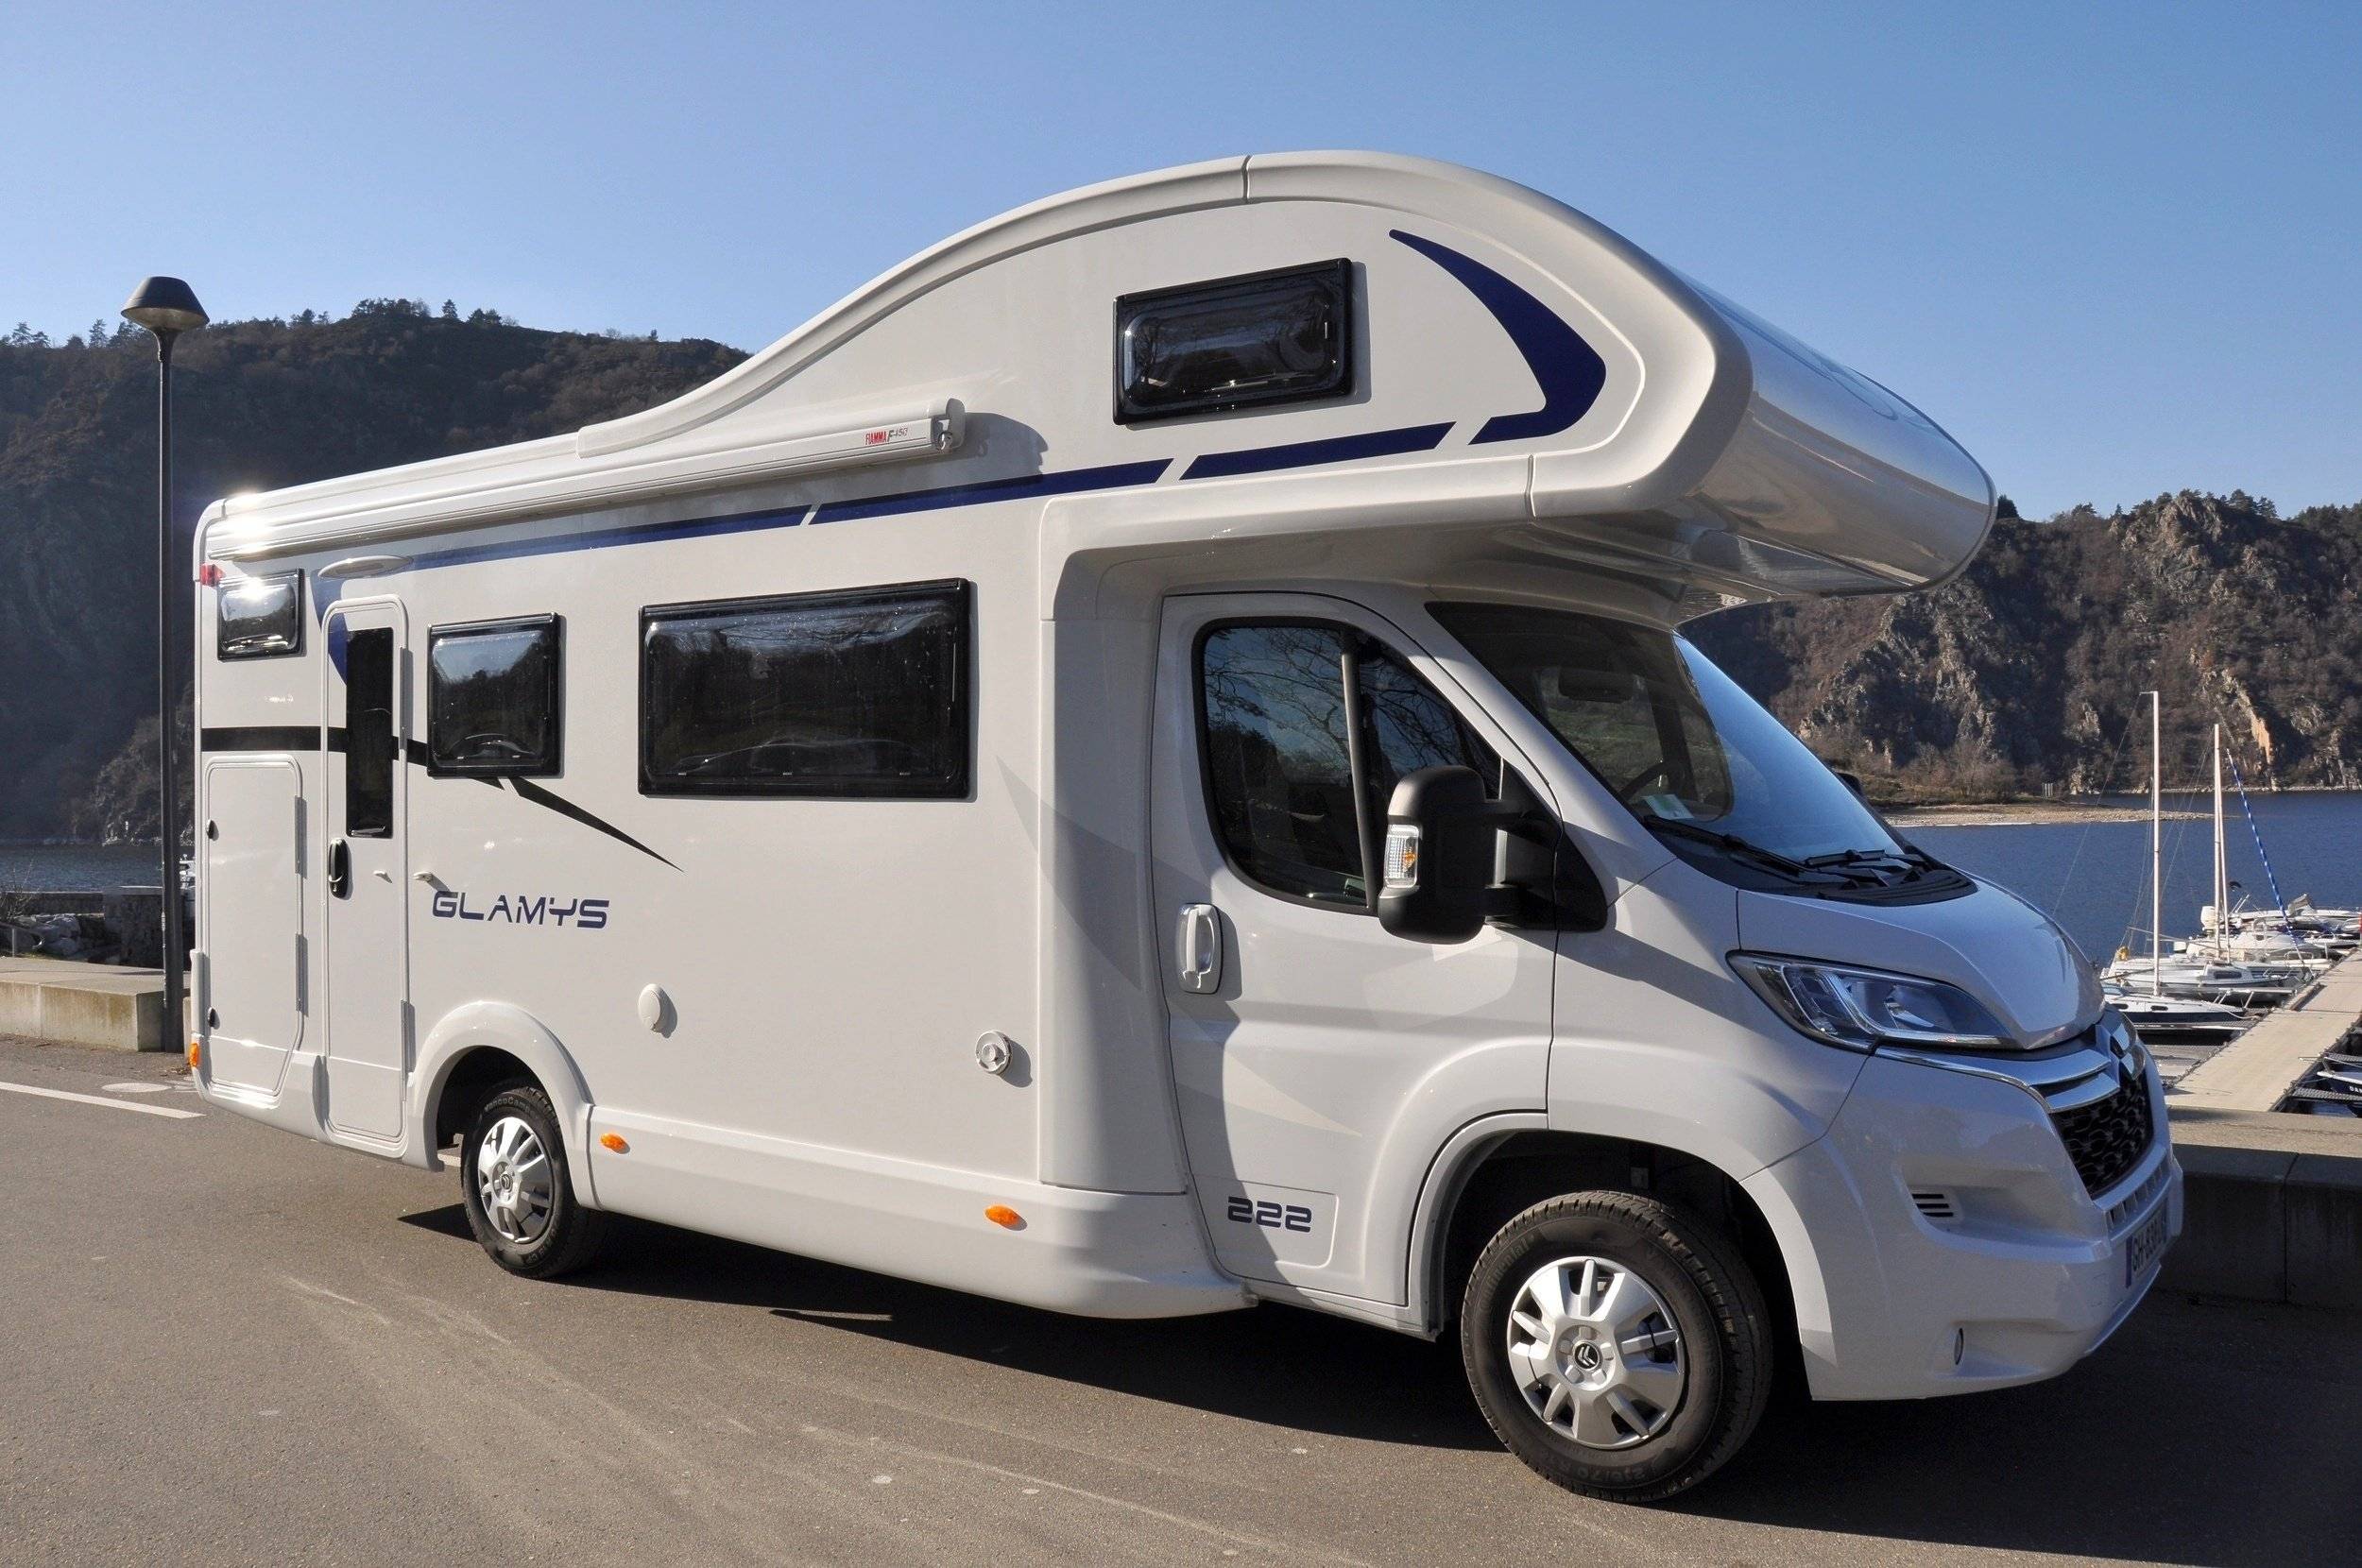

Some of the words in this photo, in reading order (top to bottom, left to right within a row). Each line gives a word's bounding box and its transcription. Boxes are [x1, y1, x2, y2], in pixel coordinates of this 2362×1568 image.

[864, 431, 887, 445] FIAMMA
[432, 891, 609, 929] GLAMYS
[1227, 1196, 1311, 1233] 222
